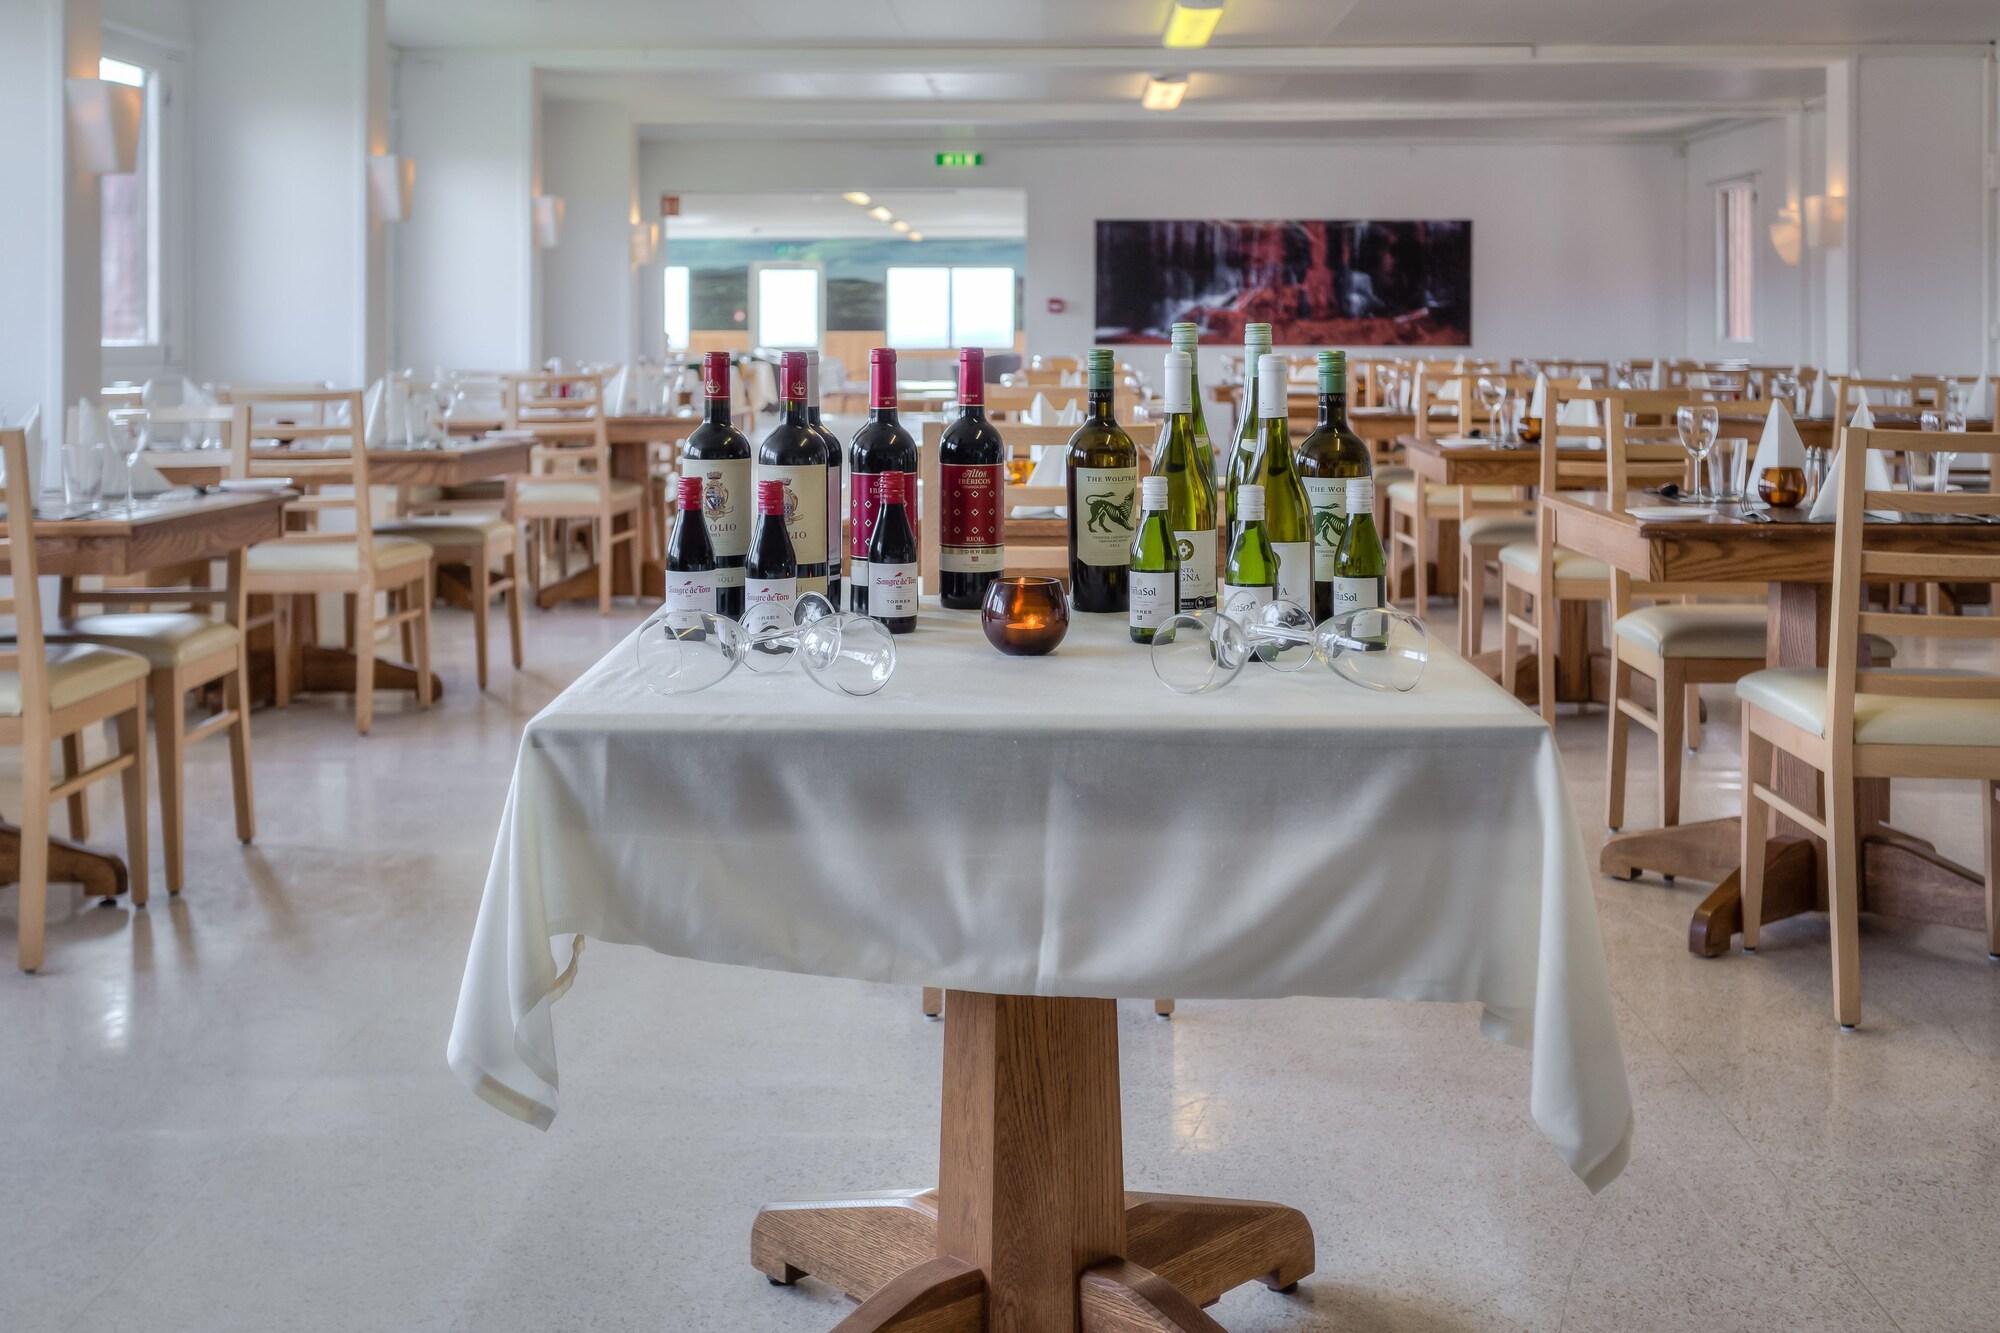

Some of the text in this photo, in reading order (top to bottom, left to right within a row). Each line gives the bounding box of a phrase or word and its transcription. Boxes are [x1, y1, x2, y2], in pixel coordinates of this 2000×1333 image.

[962, 469, 987, 478] Altos
[876, 577, 900, 587] Sangre
[668, 586, 689, 595] Sangre
